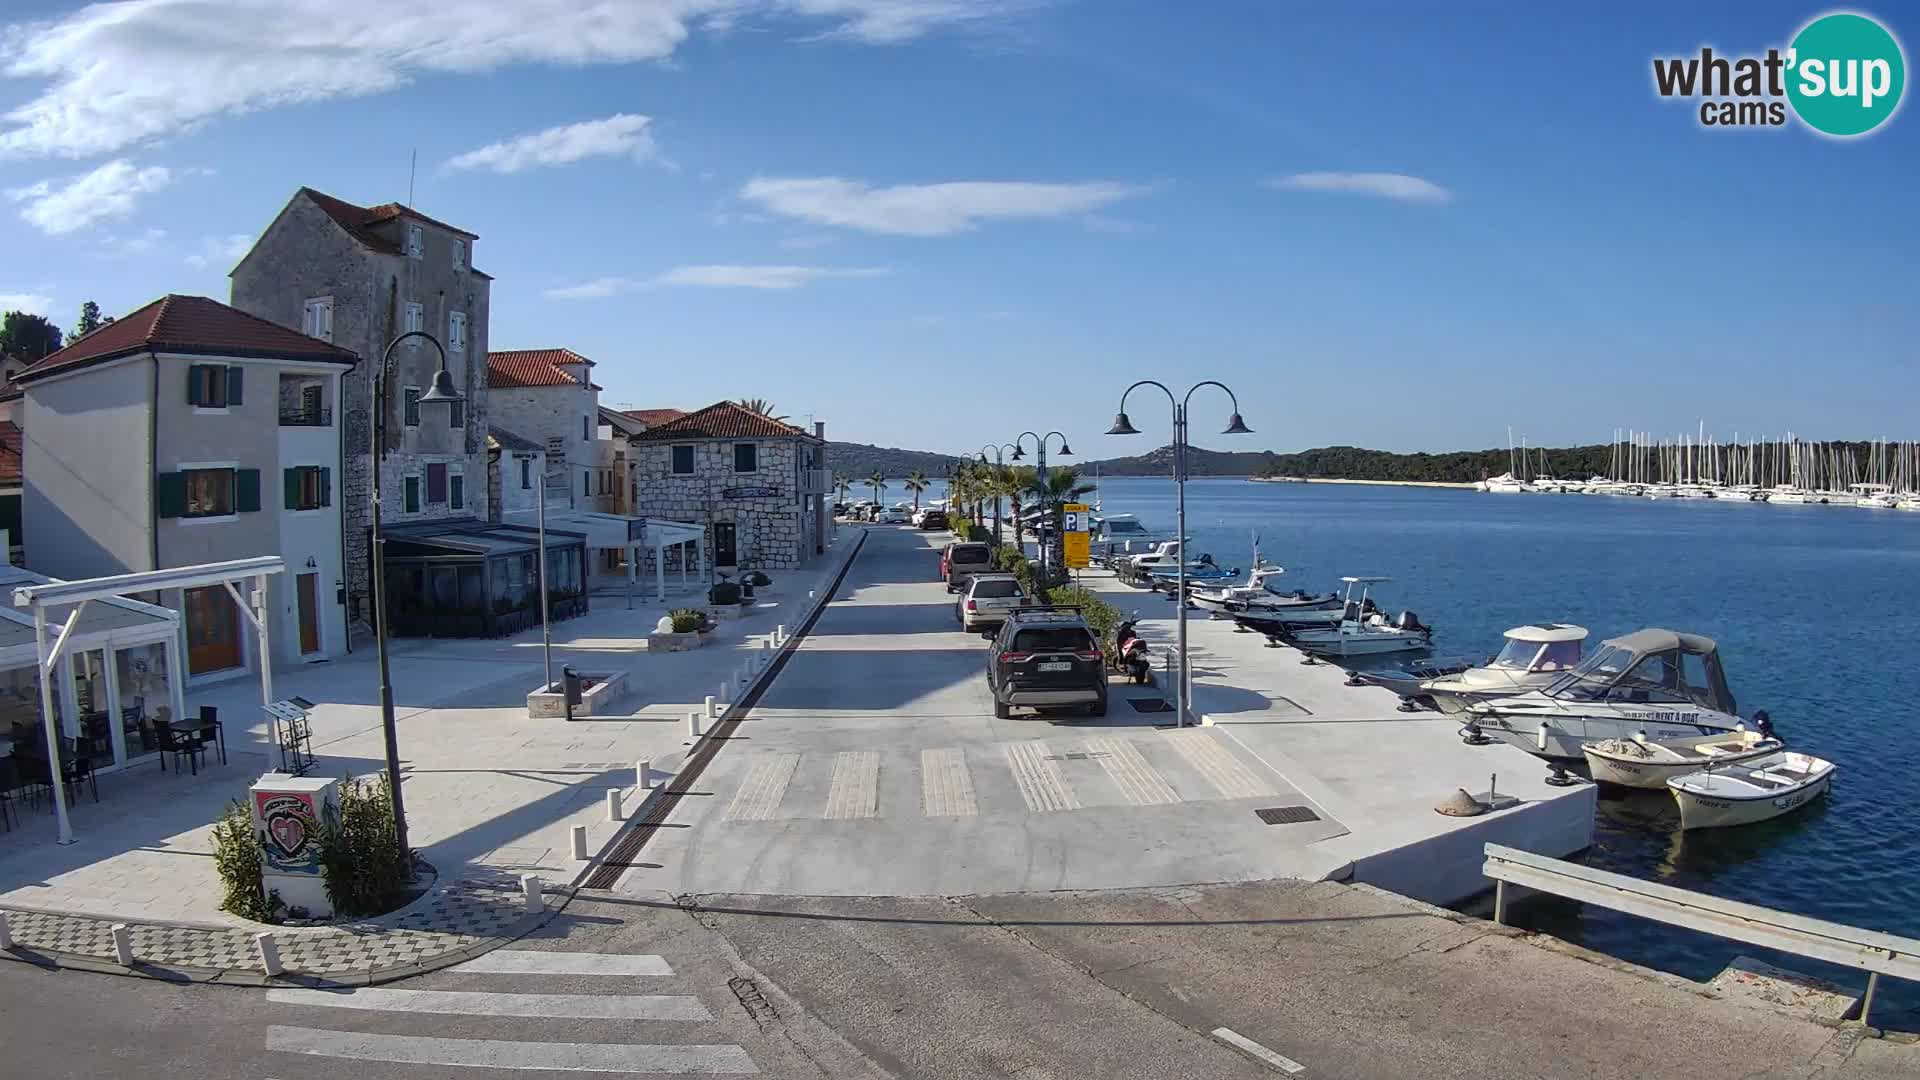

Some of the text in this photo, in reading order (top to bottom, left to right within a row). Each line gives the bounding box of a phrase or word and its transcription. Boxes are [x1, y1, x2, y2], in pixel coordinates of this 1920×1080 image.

[1066, 513, 1076, 530] P
[1655, 712, 1674, 721] RENT
[1675, 711, 1680, 722] A
[1681, 713, 1700, 724] BOAT
